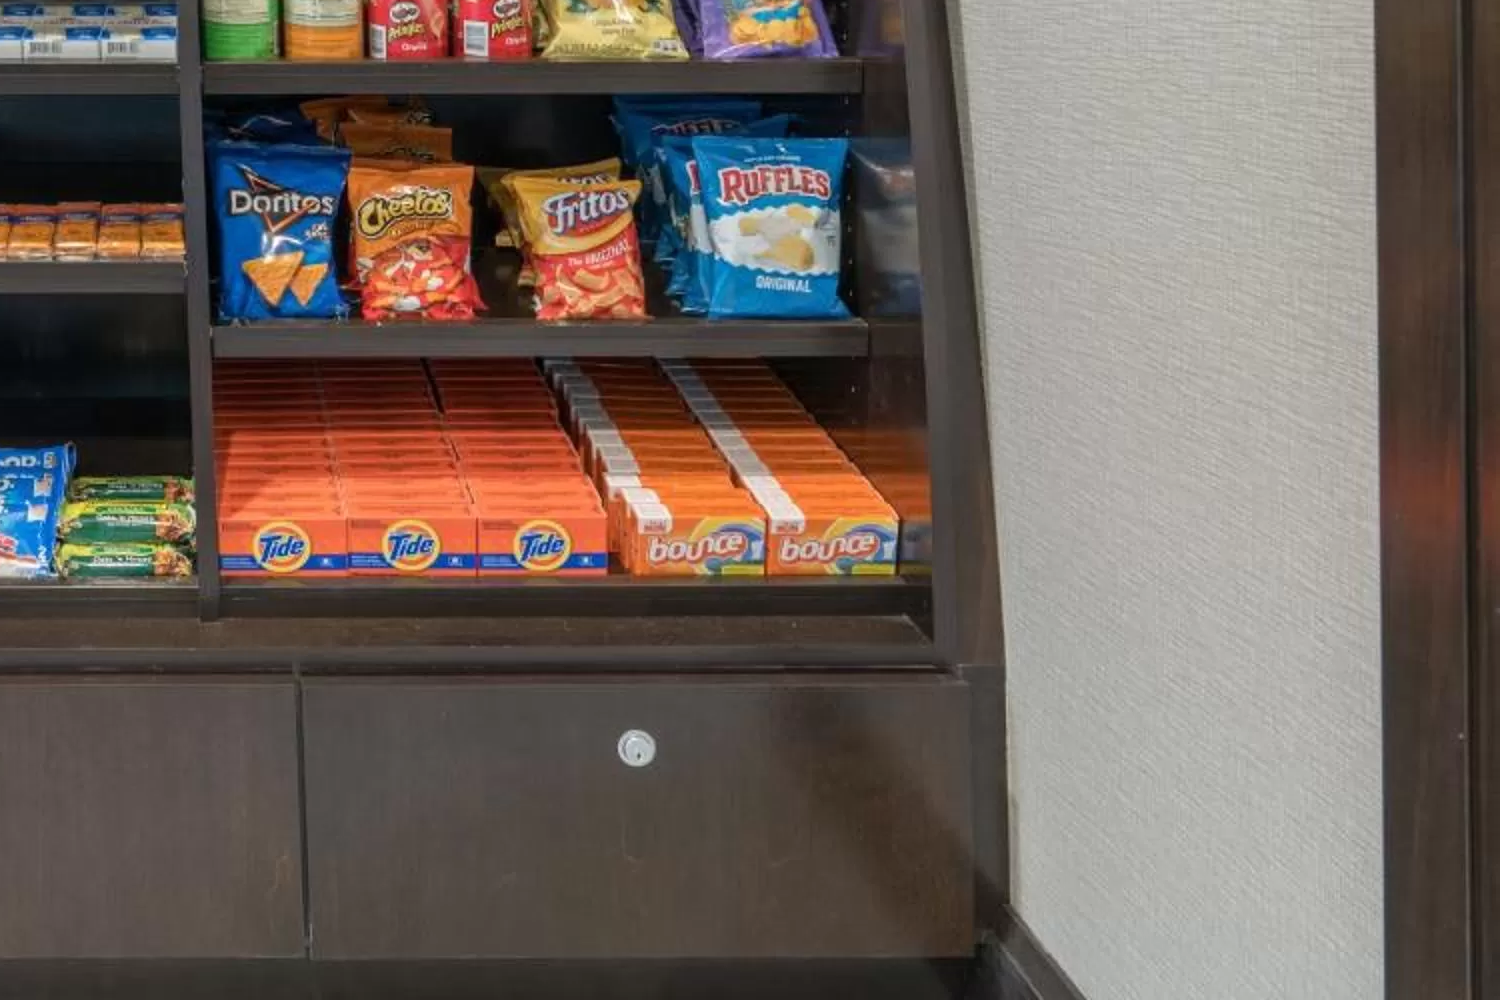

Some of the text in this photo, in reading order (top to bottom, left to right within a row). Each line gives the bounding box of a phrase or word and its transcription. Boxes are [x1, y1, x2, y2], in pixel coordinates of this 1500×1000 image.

[719, 164, 831, 205] RUFFLES
[230, 190, 334, 215] Doritos
[357, 189, 453, 238] Cheetos
[544, 190, 630, 233] Fritos
[756, 277, 812, 293] ORIGINAL
[260, 534, 305, 561] Tide
[387, 534, 434, 561] Tide
[519, 534, 566, 561] Tide
[649, 533, 748, 564] bounce
[780, 533, 880, 564] bounce
